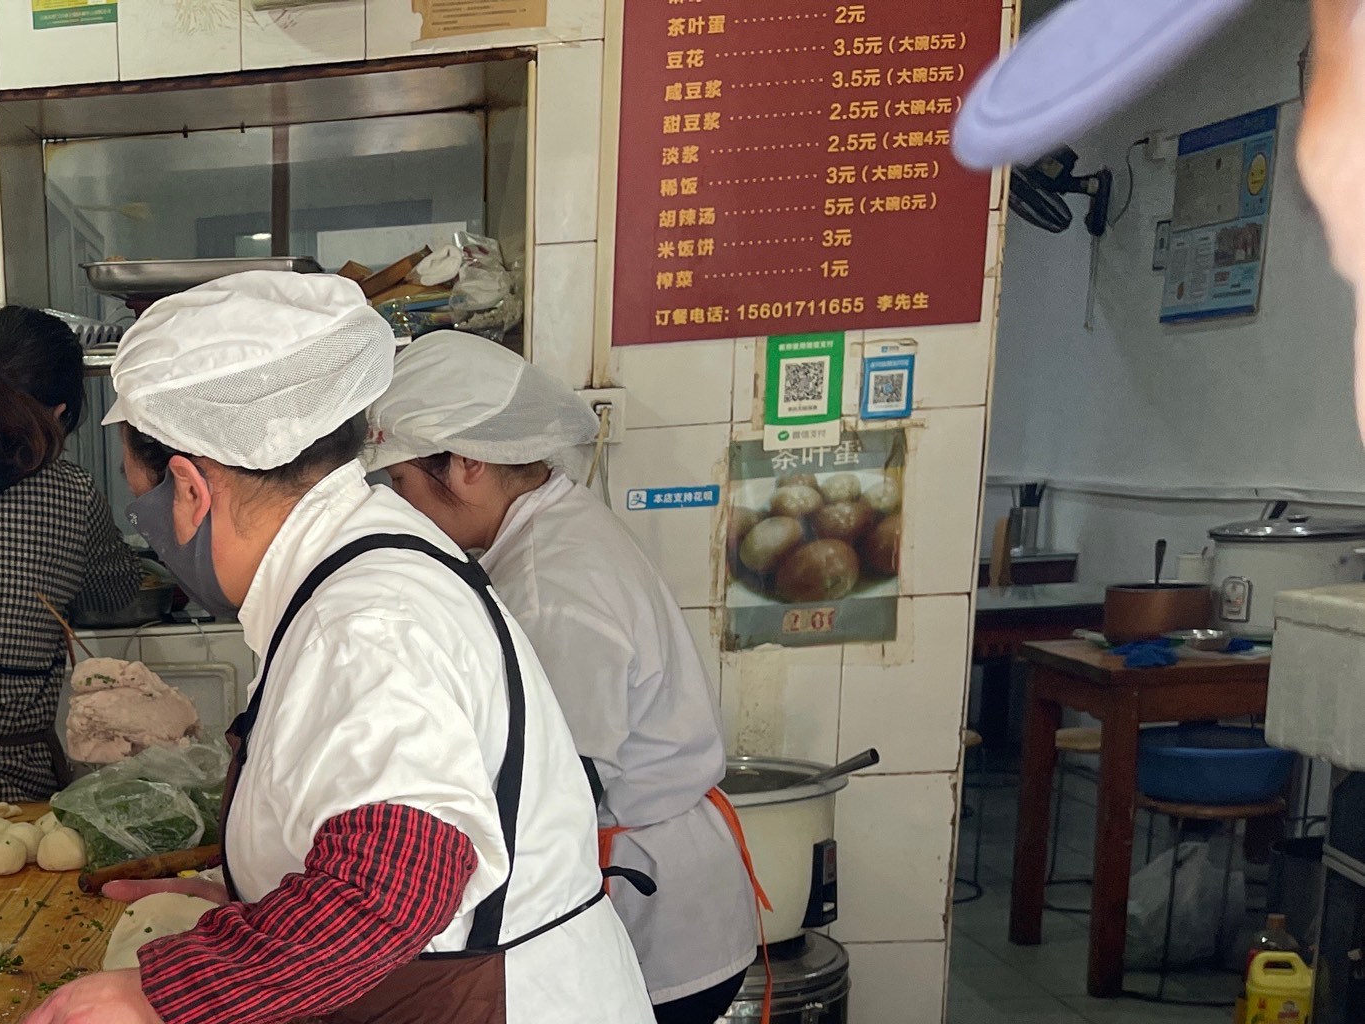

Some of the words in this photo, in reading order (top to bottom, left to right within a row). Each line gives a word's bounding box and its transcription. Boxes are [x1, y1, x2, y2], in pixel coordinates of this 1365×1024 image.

[667, 15, 725, 37] 茶叶蛋
[834, 5, 866, 24] 2元
[666, 49, 705, 69] 豆花
[664, 80, 723, 102] 咸豆浆
[662, 112, 721, 134] 甜豆浆
[661, 145, 700, 165] 淡浆
[659, 176, 698, 197] 稀饭
[658, 207, 716, 228] 胡辣汤
[657, 238, 715, 259] 米饭饼
[822, 228, 852, 247] 3元
[655, 270, 694, 290] 榨菜
[819, 259, 849, 278] 1元
[737, 297, 864, 320] 15601711655
[876, 293, 929, 312] 李先生
[771, 440, 861, 470] 茶叶蛋
[653, 490, 713, 504] 本店支持花呗
